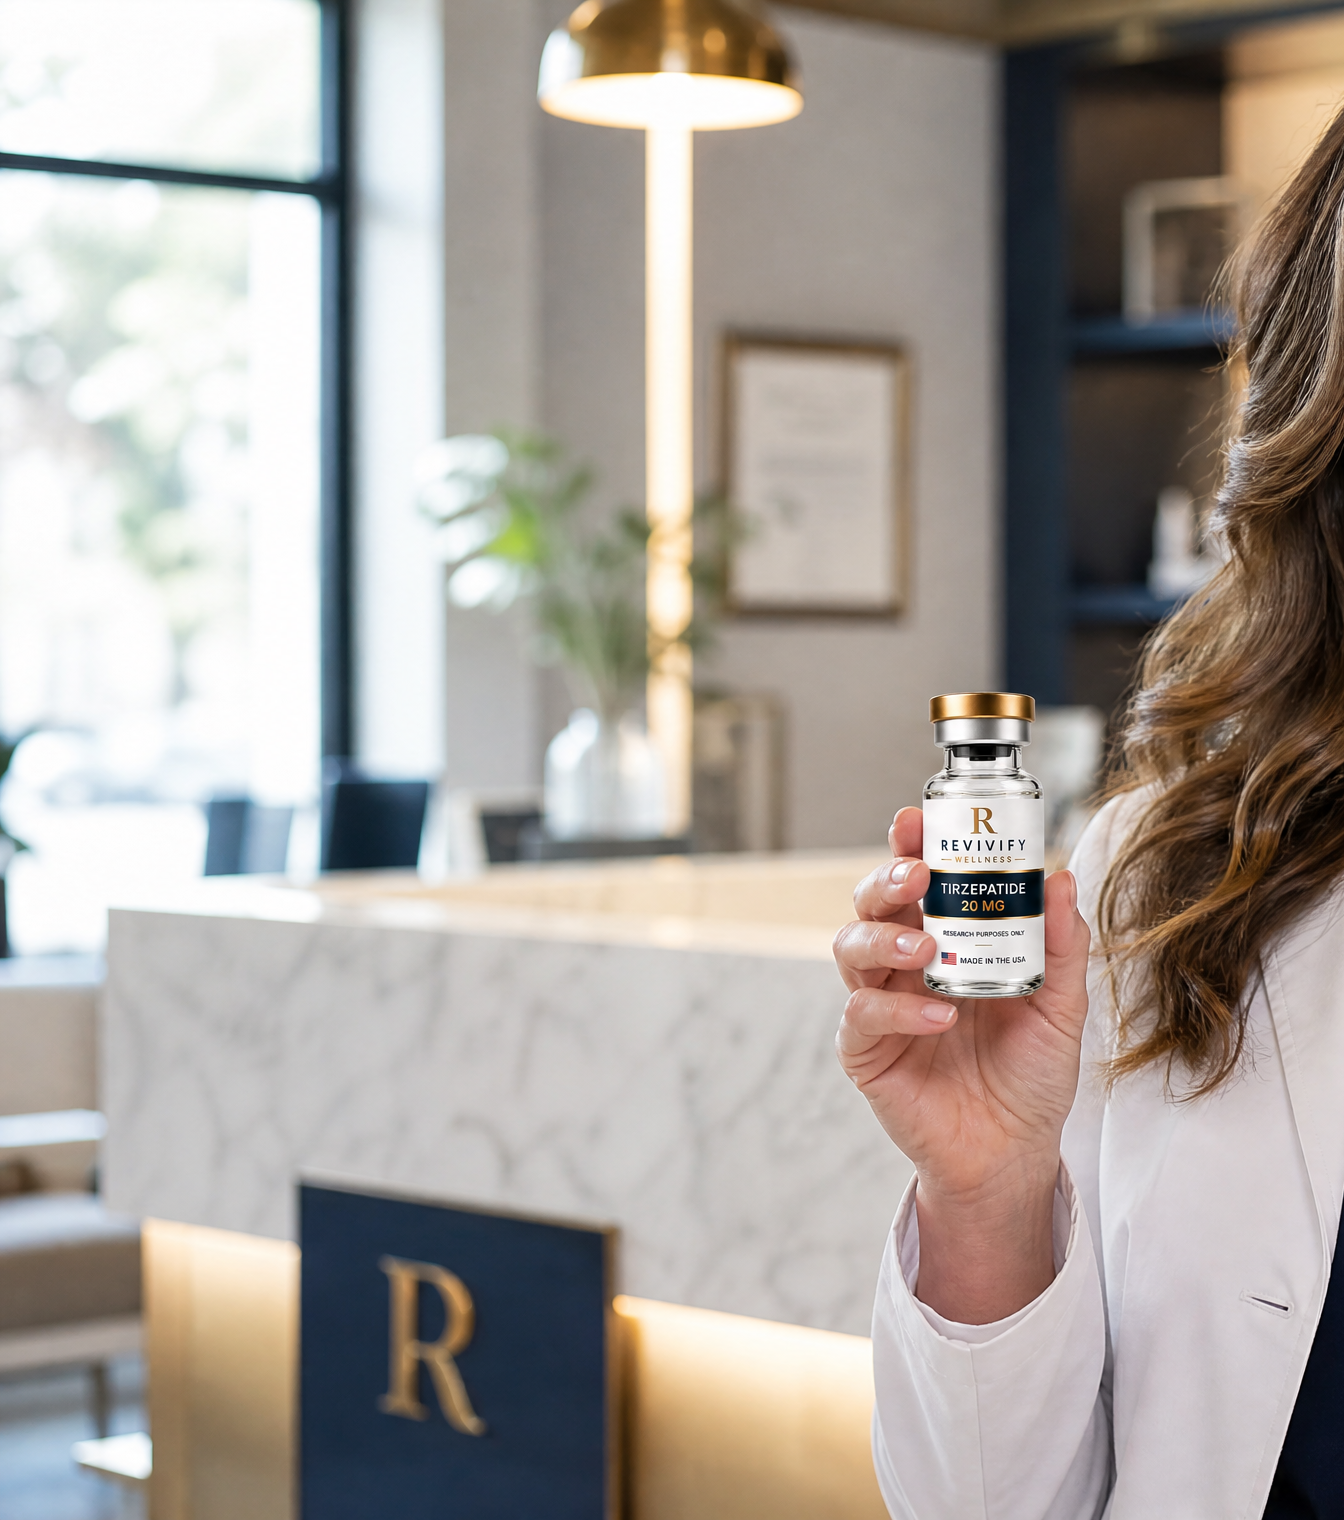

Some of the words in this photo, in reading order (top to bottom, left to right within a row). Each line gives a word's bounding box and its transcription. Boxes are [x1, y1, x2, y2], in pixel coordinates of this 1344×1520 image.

[970, 807, 998, 835] R
[941, 839, 1026, 852] REVIVIFY
[954, 856, 1012, 864] WELLNESS
[940, 882, 1026, 895] TIRZEPATIDE
[961, 900, 978, 912] 20
[982, 900, 1005, 912] MG
[975, 930, 1009, 938] PURPOSES
[960, 957, 983, 965] MADE
[985, 957, 993, 965] IN
[995, 956, 1011, 964] THE
[1012, 955, 1026, 964] USA
[376, 1253, 488, 1438] R
